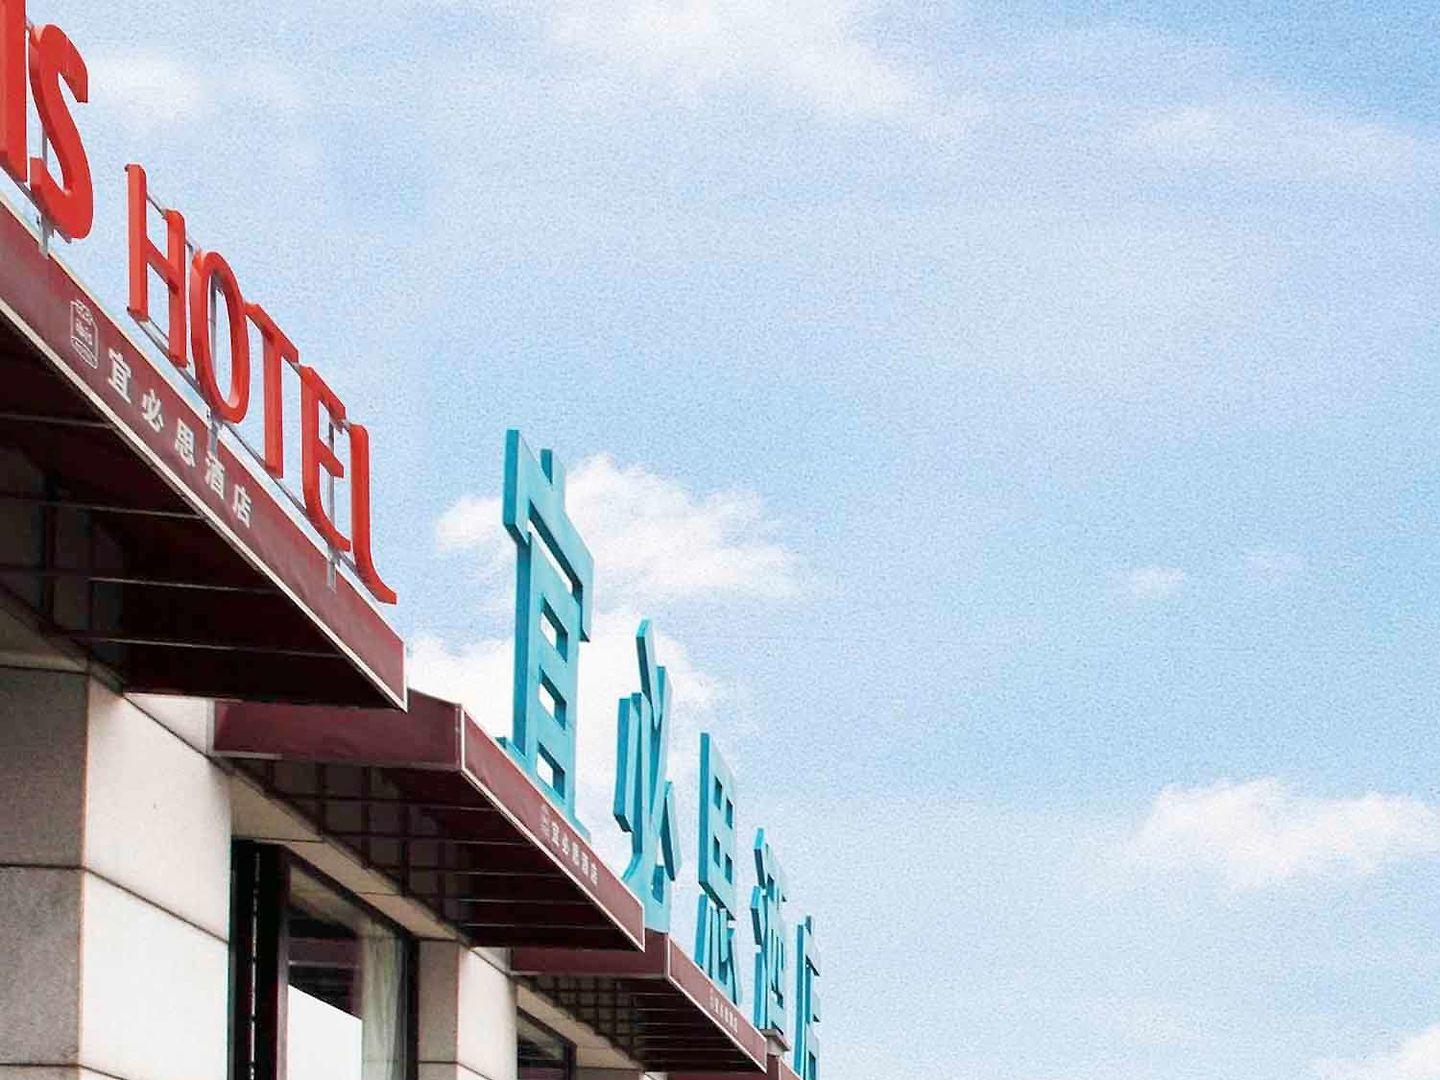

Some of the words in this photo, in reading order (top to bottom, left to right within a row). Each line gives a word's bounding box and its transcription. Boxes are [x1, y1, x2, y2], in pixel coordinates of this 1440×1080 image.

[109, 348, 252, 528] 宜必思酒店
[125, 163, 397, 605] HOTEL
